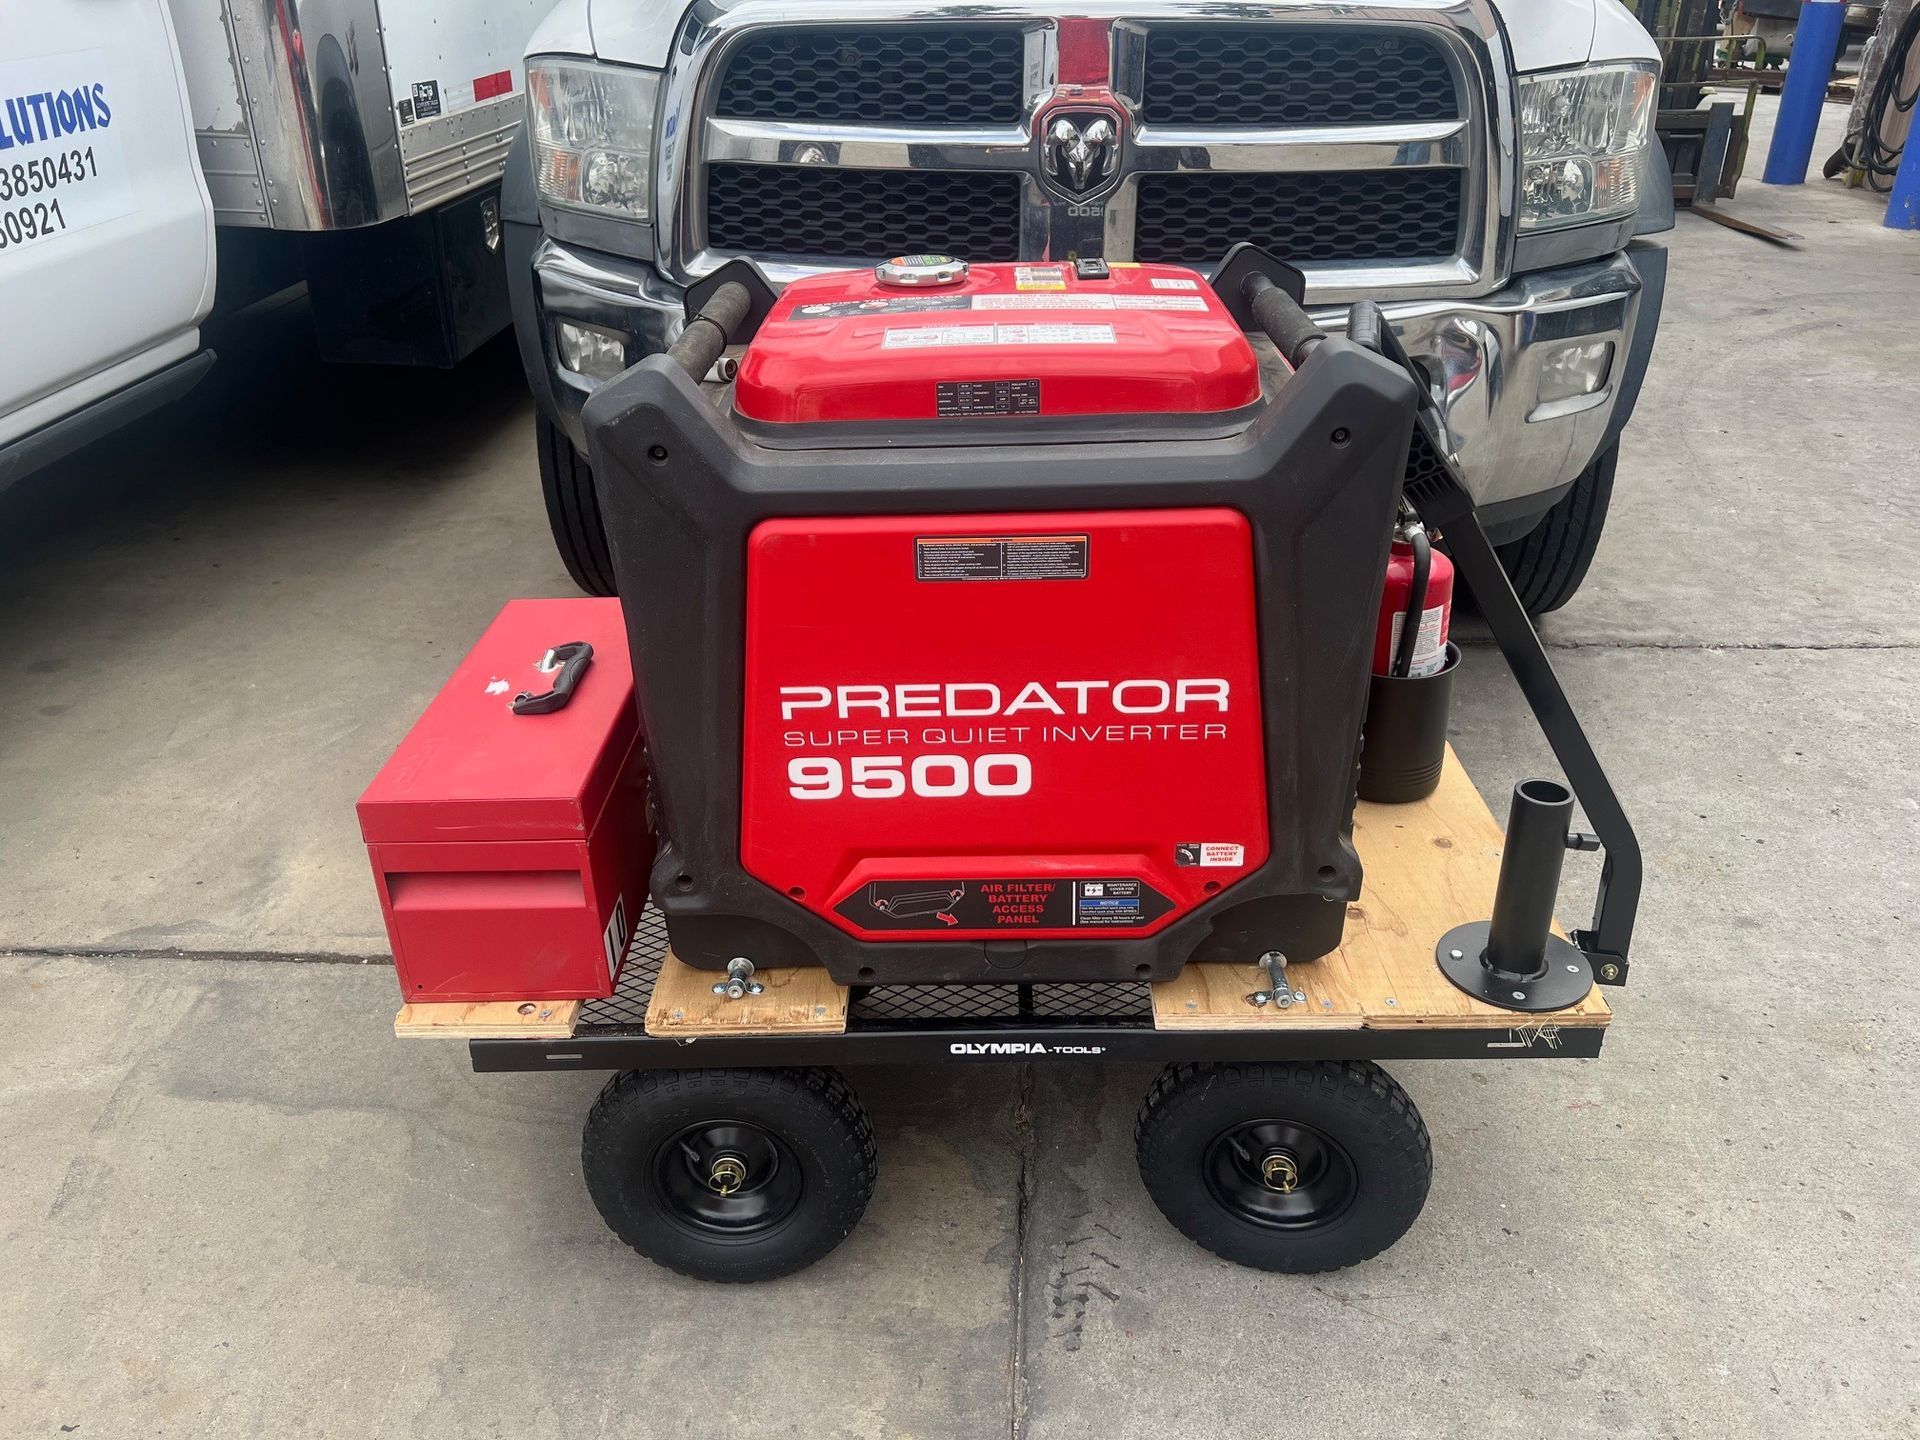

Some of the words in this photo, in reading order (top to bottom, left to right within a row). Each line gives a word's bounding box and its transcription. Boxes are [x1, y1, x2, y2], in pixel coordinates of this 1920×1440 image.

[780, 678, 1230, 720] PREDATOR
[784, 729, 909, 747] SUPER
[922, 727, 1030, 744] QUIET
[1043, 724, 1227, 742] INVERTER
[787, 753, 1032, 800] 9500
[981, 884, 1003, 892] AIR
[1007, 883, 1055, 892] FILTER/
[988, 894, 1048, 903] BATTERY
[993, 905, 1044, 913] ACCESS
[998, 916, 1040, 924] PANEL
